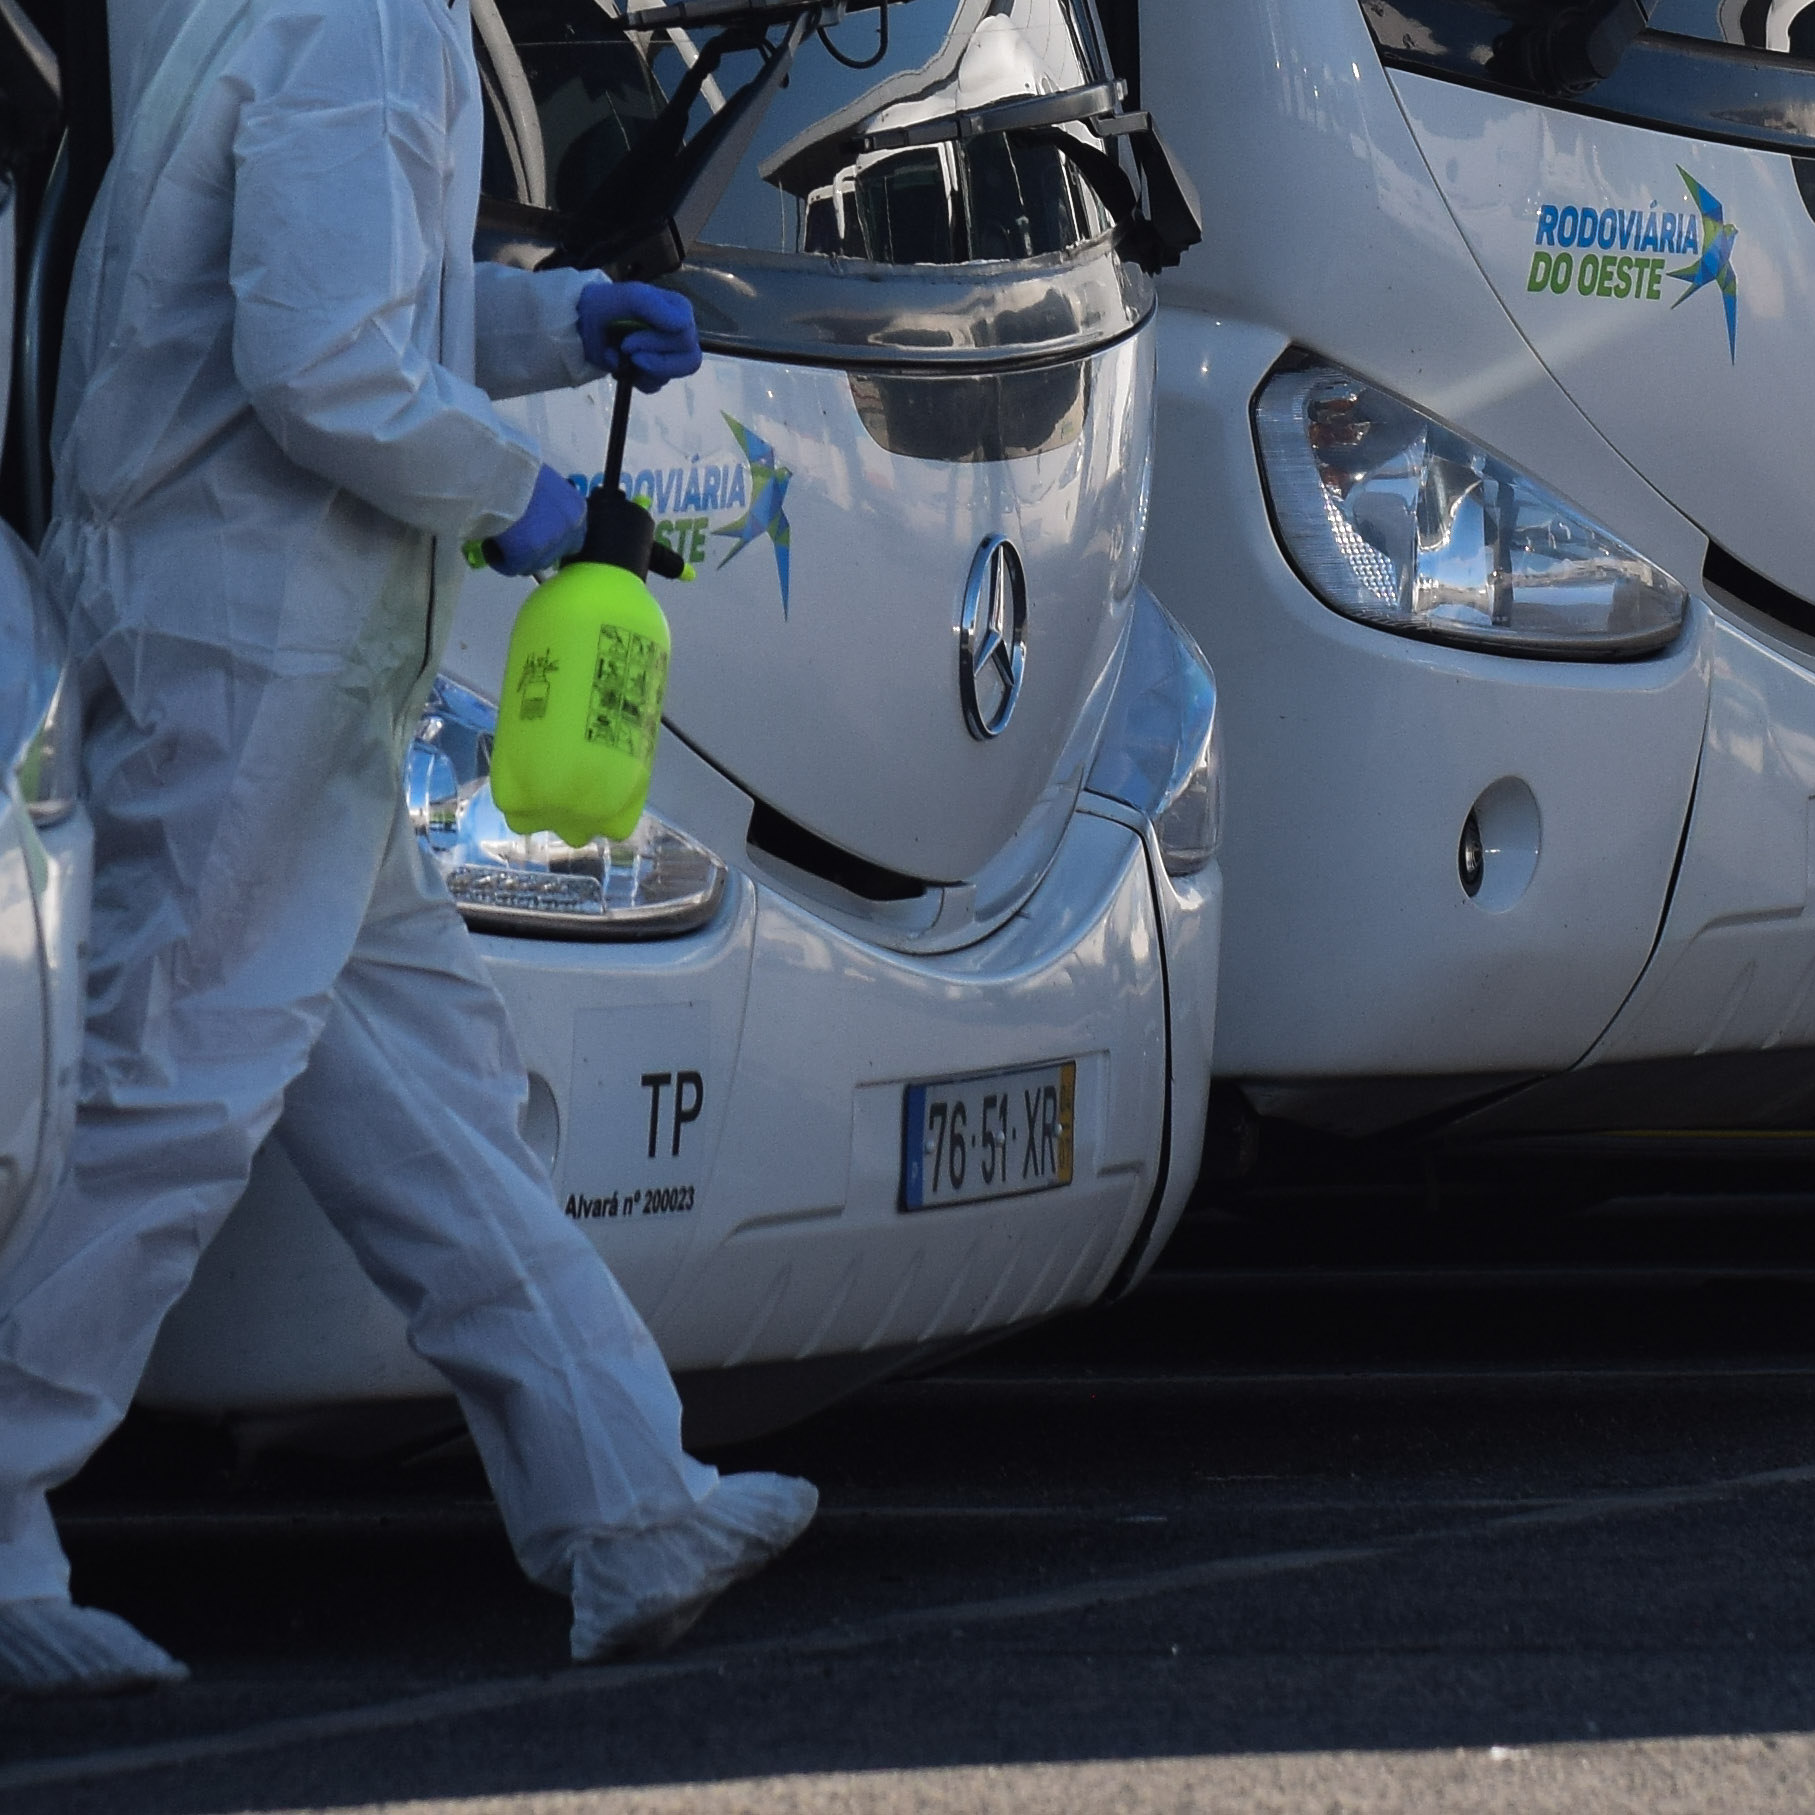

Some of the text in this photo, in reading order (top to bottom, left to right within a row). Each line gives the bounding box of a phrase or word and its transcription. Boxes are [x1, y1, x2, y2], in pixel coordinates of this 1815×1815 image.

[1536, 199, 1698, 254] RODOVIÁRIA
[1527, 251, 1665, 300] DO OESTE
[641, 1071, 704, 1158] TP
[565, 1189, 618, 1219] Alvará
[642, 1185, 695, 1215] 200023
